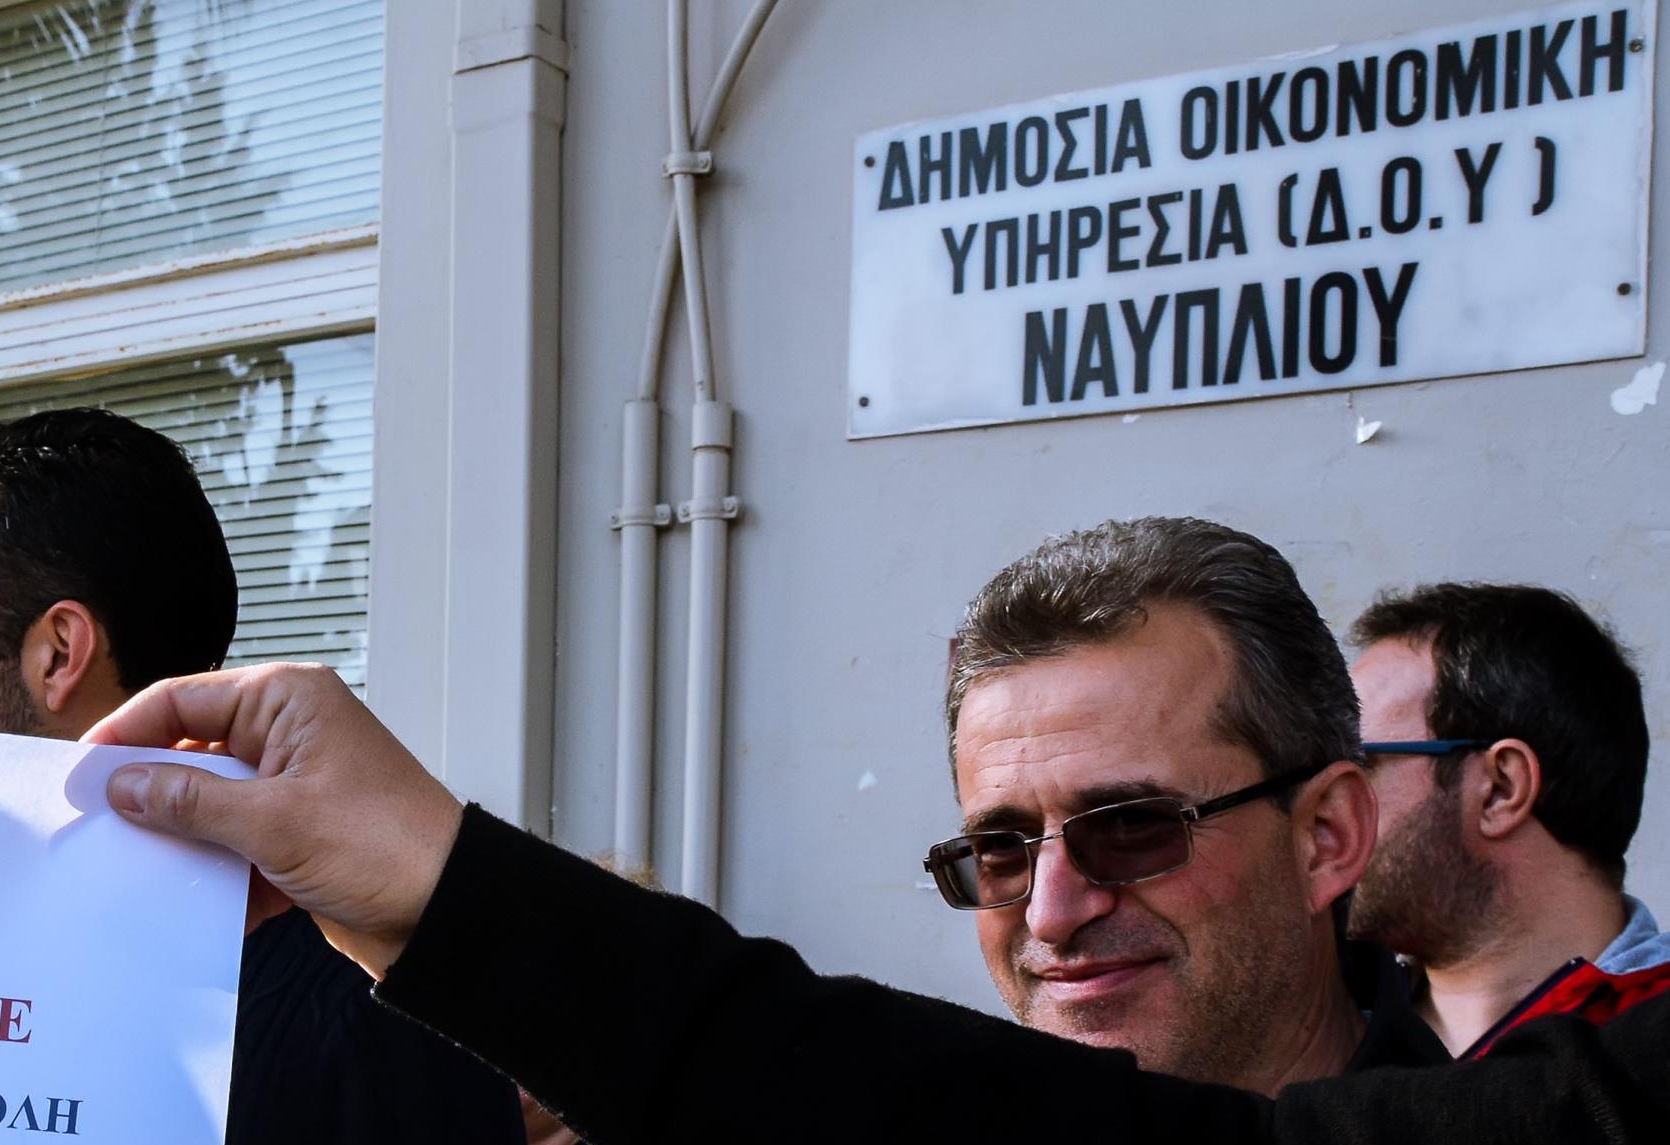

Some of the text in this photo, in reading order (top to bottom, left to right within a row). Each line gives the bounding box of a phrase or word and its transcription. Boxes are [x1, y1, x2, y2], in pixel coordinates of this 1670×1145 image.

[877, 9, 1629, 212] ΔΗΜΟΣΙΑ ΟΙΚΟΝΟΜΙΚΗ
[941, 183, 1248, 296] ΥΠΗΡΕΣΙΑ
[1021, 262, 1421, 407] ΝΑΥΠΛΙΟΥ
